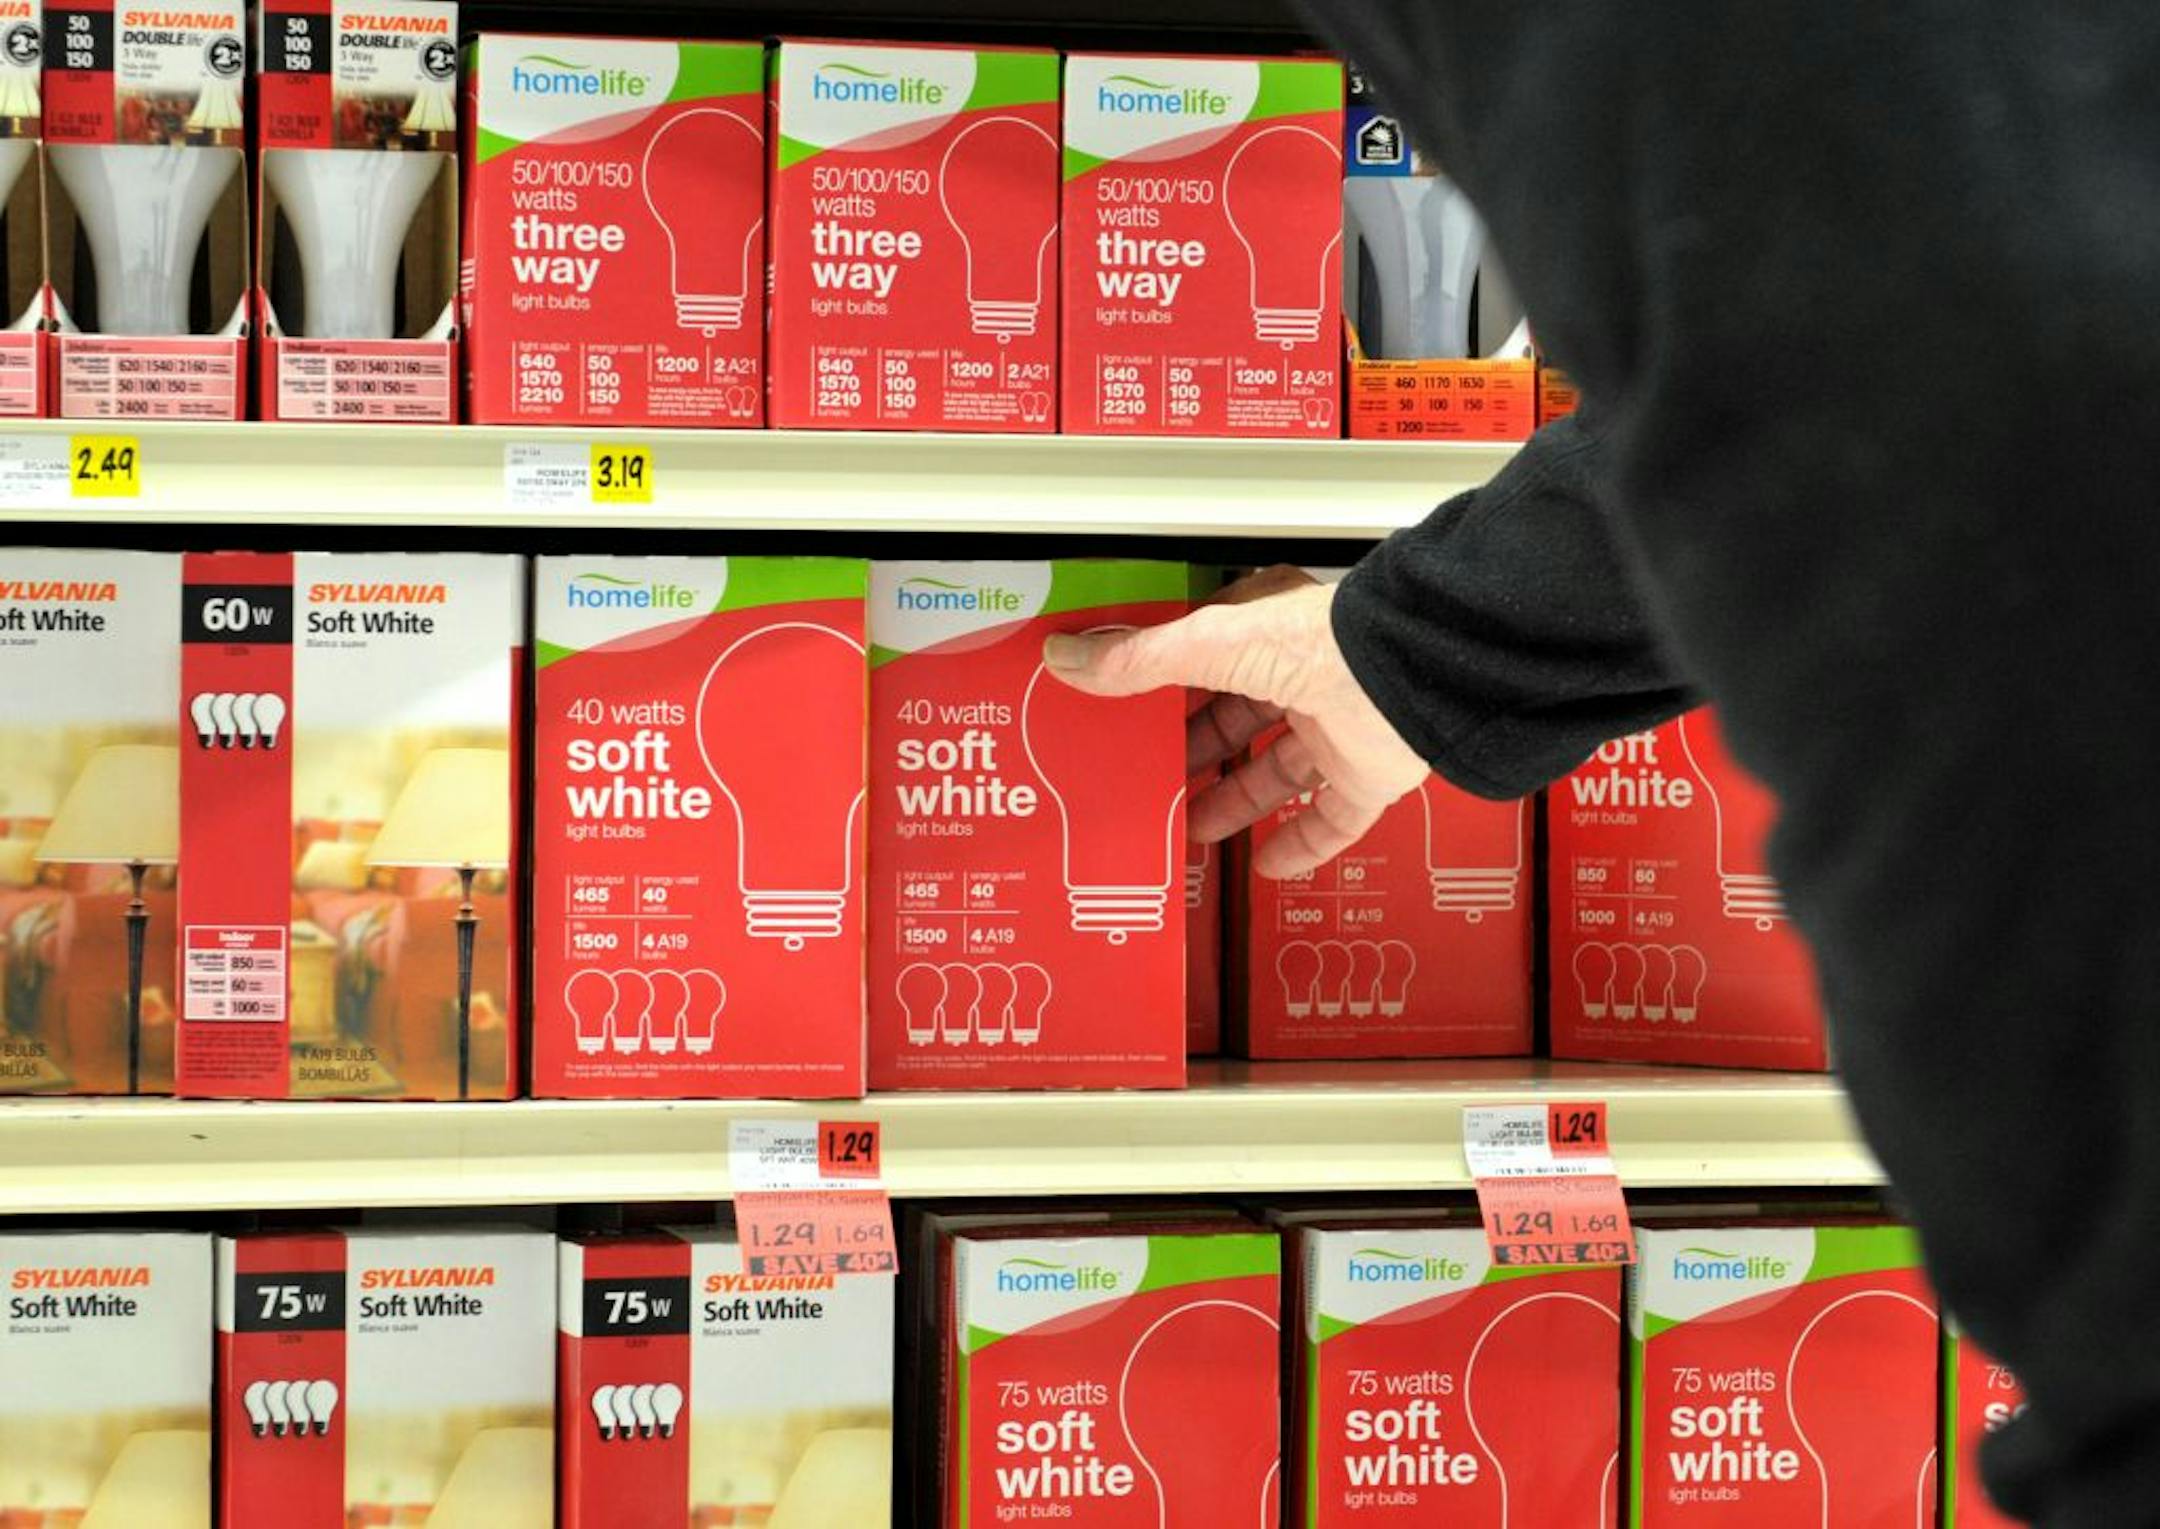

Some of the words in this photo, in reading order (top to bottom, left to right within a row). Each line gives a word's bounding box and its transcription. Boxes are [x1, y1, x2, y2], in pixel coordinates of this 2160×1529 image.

[69, 16, 89, 31] 50
[124, 12, 235, 29] SYLVANIA
[288, 18, 307, 34] 50
[341, 15, 447, 33] SYLVANIA
[67, 34, 93, 49] 100
[122, 31, 185, 45] DOUBLE
[285, 36, 311, 52] 100
[340, 34, 400, 48] DOUBLE
[67, 52, 93, 67] 150
[286, 54, 311, 70] 150
[513, 67, 645, 96] homelife
[814, 74, 942, 104] homelife
[1099, 87, 1226, 115] homelife
[512, 160, 632, 188] 50/100/150
[813, 167, 930, 194] 50/100/150
[512, 188, 577, 211] watts
[1098, 178, 1213, 204] 50/100/150
[812, 194, 876, 217] watts
[1097, 205, 1159, 227] watts
[511, 215, 624, 251] three
[811, 221, 921, 258] three
[1097, 231, 1205, 266] three
[512, 257, 600, 292] way
[812, 262, 897, 297] way
[1097, 272, 1181, 306] way
[512, 293, 543, 312] light
[550, 295, 590, 310] bulbs
[812, 299, 842, 316] light
[847, 300, 888, 314] bulbs
[1097, 308, 1128, 325] light
[1132, 309, 1172, 323] bulbs
[118, 360, 142, 372] 620
[150, 362, 174, 372] 1540
[179, 360, 207, 373] 2160
[520, 354, 555, 369] 640
[588, 356, 611, 370] 50
[656, 357, 699, 372] 1200
[714, 358, 725, 373] 2
[728, 358, 756, 374] A21
[819, 358, 853, 373] 640
[885, 360, 907, 375] 50
[952, 362, 993, 377] 1200
[521, 371, 562, 386] 1570
[589, 372, 619, 387] 100
[1008, 364, 1019, 378] 2
[1021, 364, 1049, 379] A21
[118, 379, 134, 392] 50
[140, 380, 161, 392] 100
[167, 380, 186, 392] 150
[819, 375, 859, 390] 1570
[886, 377, 916, 392] 100
[1395, 377, 1416, 389] 460
[1425, 377, 1450, 388] 1170
[1459, 377, 1484, 389] 1630
[520, 387, 563, 402] 2210
[589, 389, 619, 403] 150
[819, 391, 861, 406] 2210
[885, 393, 916, 408] 150
[117, 400, 148, 414] 2400
[1400, 399, 1413, 411] 50
[1430, 399, 1448, 411] 100
[1464, 398, 1483, 411] 150
[1397, 421, 1423, 433] 1200
[78, 447, 134, 479] 2.49
[598, 456, 643, 487] 3.19
[0, 582, 116, 601] YLVANIA
[309, 584, 445, 603] SYLVANIA
[569, 584, 693, 608] homelife
[898, 587, 1019, 611] homelife
[32, 609, 104, 631] White
[308, 611, 355, 632] Soft
[362, 611, 433, 634] White
[567, 699, 604, 725] 40
[611, 701, 685, 725] watts
[898, 700, 932, 724] 40
[939, 702, 1011, 725] watts
[568, 730, 670, 772] soft
[898, 730, 996, 770] soft
[1586, 731, 1659, 764] oft
[566, 776, 711, 818] white
[897, 775, 1036, 816] white
[1572, 768, 1693, 808] white
[1572, 810, 1598, 826] light
[1602, 811, 1637, 825] bulbs
[567, 824, 598, 841] light
[603, 824, 645, 838] bulbs
[897, 822, 927, 838] light
[932, 822, 973, 835] bulbs
[574, 888, 609, 902] 465
[643, 888, 666, 902] 40
[905, 883, 939, 897] 465
[971, 884, 994, 897] 40
[1636, 912, 1645, 924] 4
[1649, 912, 1673, 926] A19
[574, 934, 617, 948] 1500
[643, 935, 654, 948] 4
[657, 934, 688, 949] A19
[905, 929, 947, 943] 1500
[971, 929, 982, 942] 4
[985, 928, 1015, 943] A19
[231, 957, 253, 969] 850
[232, 979, 247, 991] 60
[233, 1002, 260, 1013] 1000
[335, 1048, 377, 1061] BULBS
[299, 1067, 370, 1082] BOMBILLAS
[1555, 1112, 1596, 1143] 1.29
[829, 1131, 873, 1161] 1.29
[1494, 1212, 1553, 1236] 1.29
[1573, 1215, 1618, 1233] 1.69
[752, 1223, 814, 1246] 1.29
[836, 1225, 884, 1244] 1.69
[1509, 1246, 1578, 1262] SAVE
[764, 1255, 837, 1274] SAVE
[1349, 1258, 1464, 1281] homelife
[1674, 1257, 1785, 1279] homelife
[12, 1268, 149, 1289] SYLVANIA
[361, 1268, 494, 1288] SYLVANIA
[705, 1275, 834, 1292] SYLVANIA
[998, 1267, 1117, 1291] homelife
[11, 1295, 59, 1318] Soft
[66, 1294, 136, 1317] White
[361, 1295, 407, 1318] Soft
[414, 1294, 482, 1316] White
[705, 1299, 749, 1322] Soft
[756, 1298, 822, 1320] White
[1348, 1370, 1378, 1395] 75
[1385, 1371, 1453, 1394] watts
[1672, 1368, 1701, 1392] 75
[1709, 1368, 1775, 1392] watts
[998, 1381, 1029, 1407] 75
[1037, 1381, 1108, 1405] watts
[1346, 1400, 1441, 1441] soft
[1671, 1396, 1763, 1437] soft
[998, 1410, 1095, 1453] soft
[1345, 1444, 1478, 1485] white
[1670, 1441, 1799, 1482] white
[996, 1455, 1133, 1498] white
[1345, 1492, 1374, 1509] light
[1378, 1491, 1417, 1505] bulbs
[1669, 1488, 1698, 1504] light
[1702, 1487, 1739, 1501] bulbs
[997, 1504, 1026, 1521] light
[1031, 1503, 1072, 1517] bulbs
